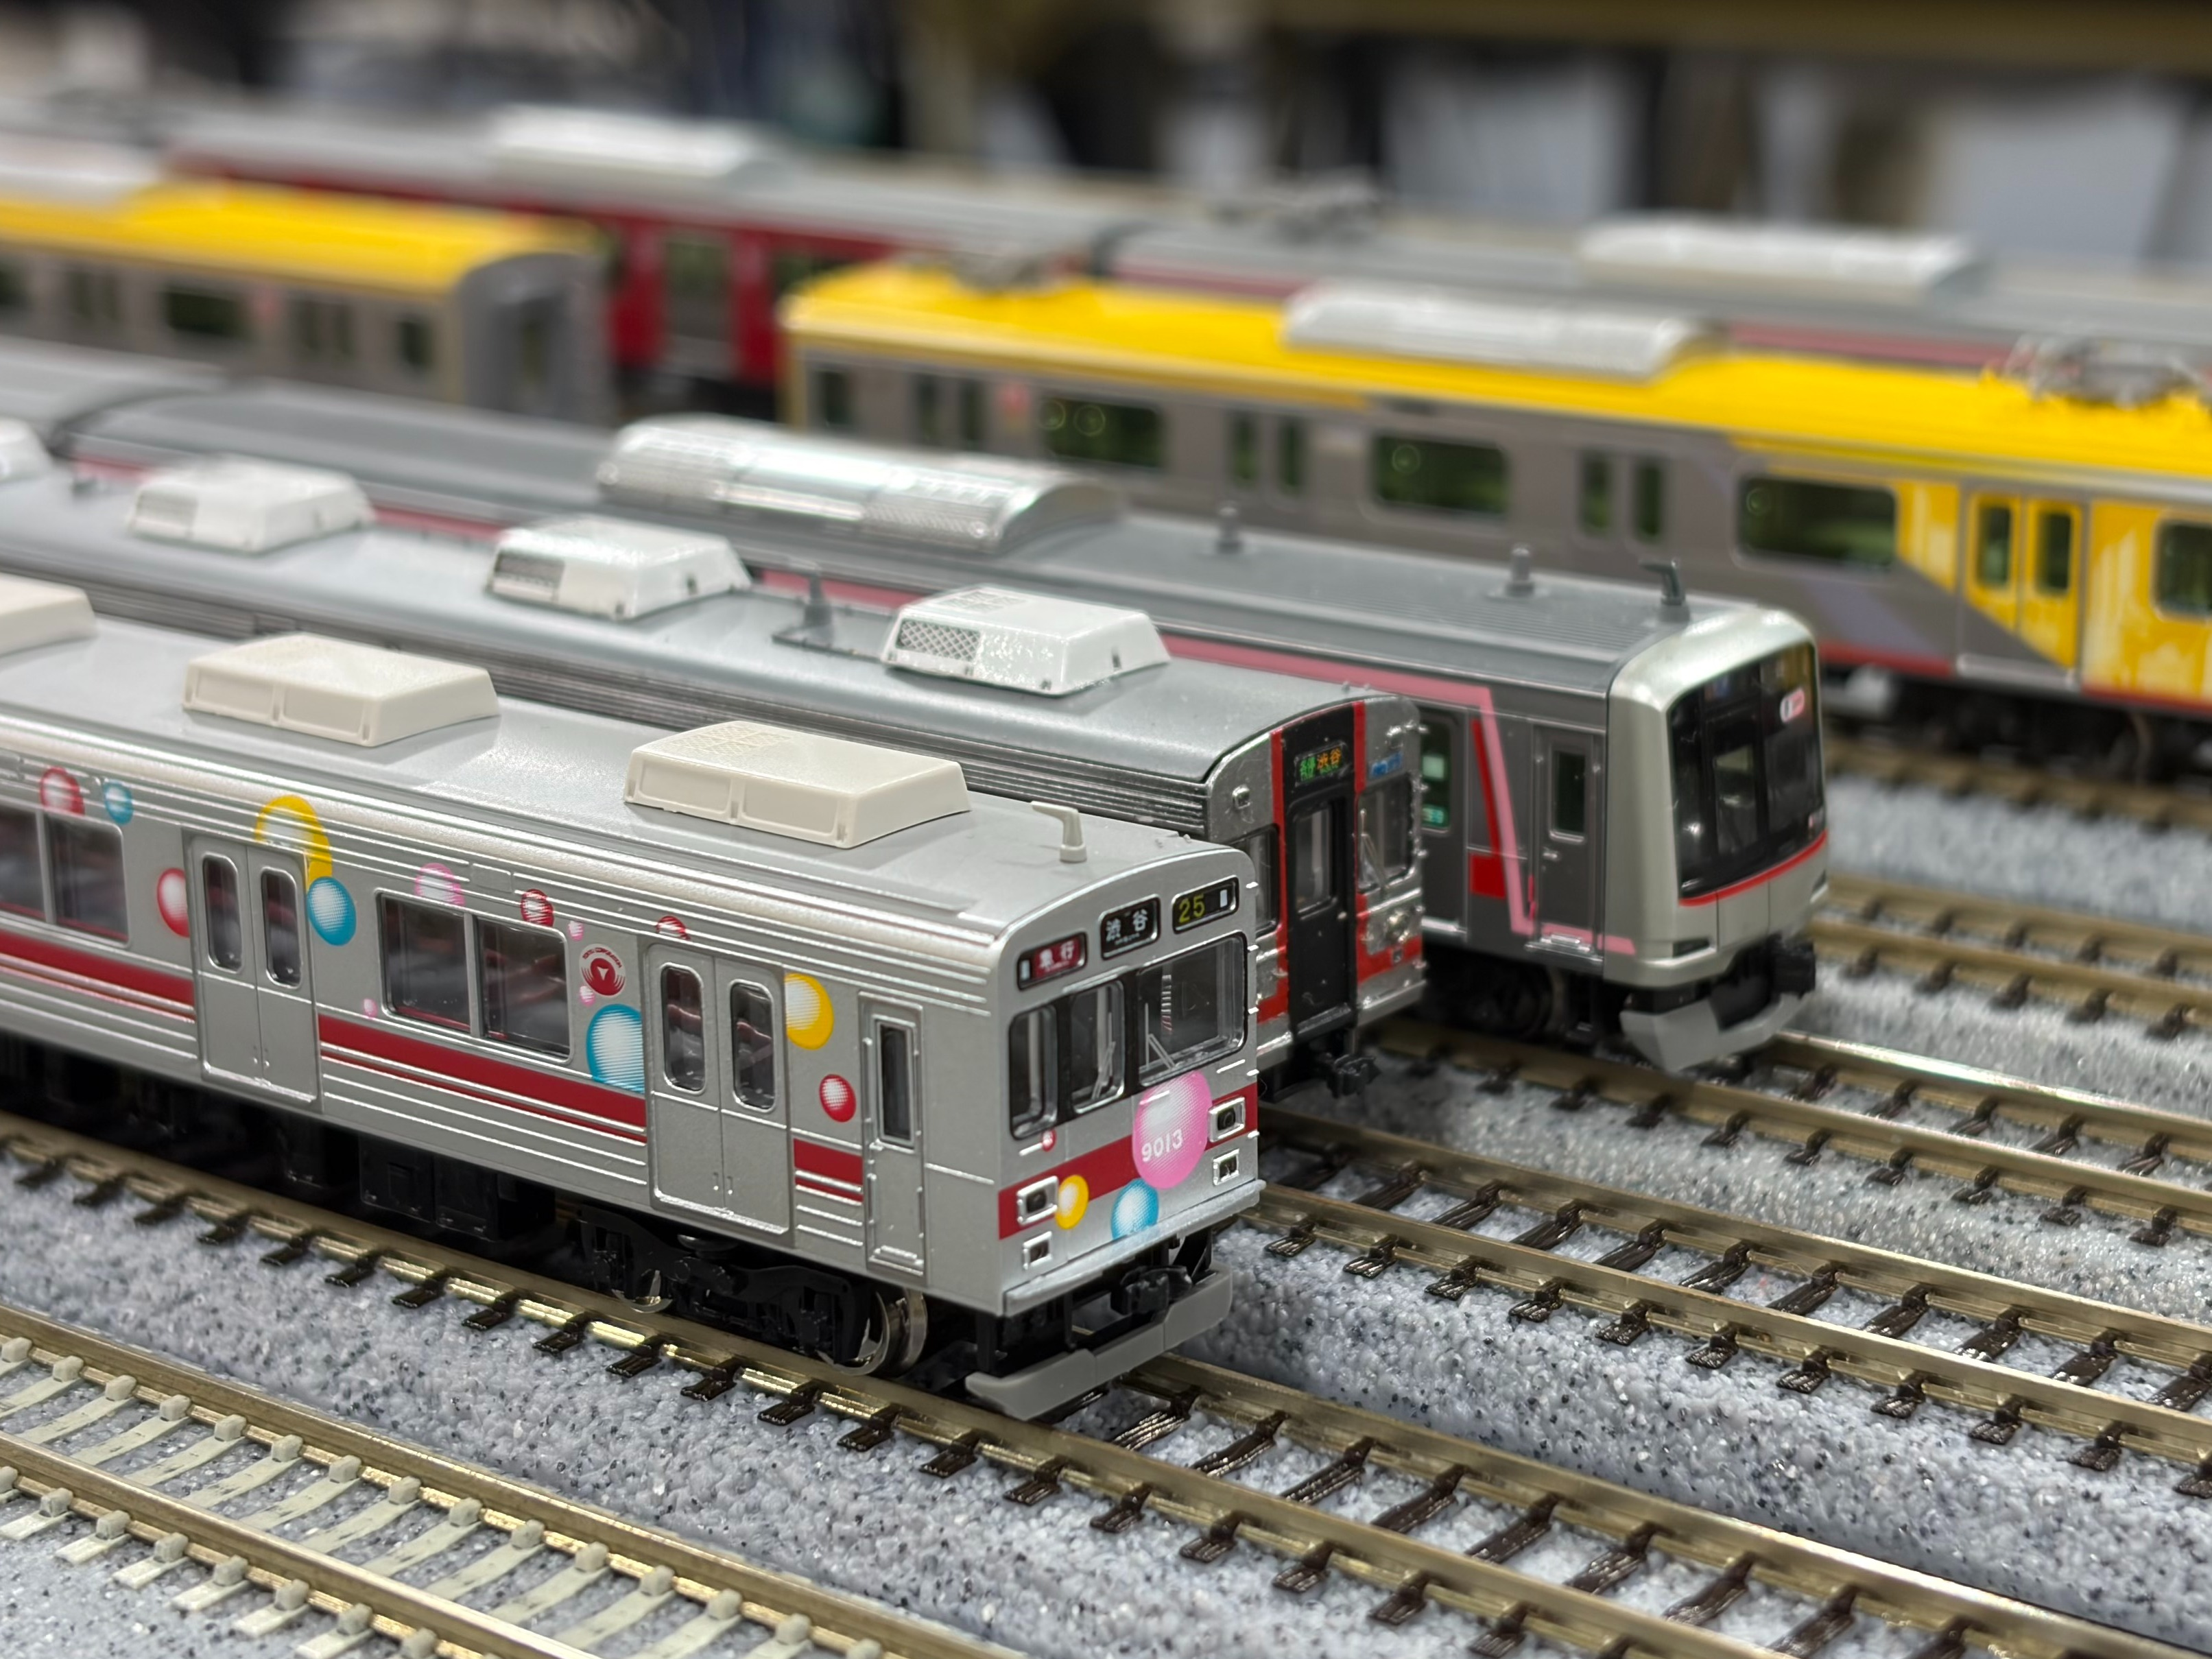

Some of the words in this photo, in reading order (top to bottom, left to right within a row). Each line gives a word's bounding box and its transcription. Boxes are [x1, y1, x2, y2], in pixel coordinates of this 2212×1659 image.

[1105, 909, 1149, 942] 渋谷
[1178, 894, 1205, 924] 25
[1141, 1128, 1185, 1162] 9013
